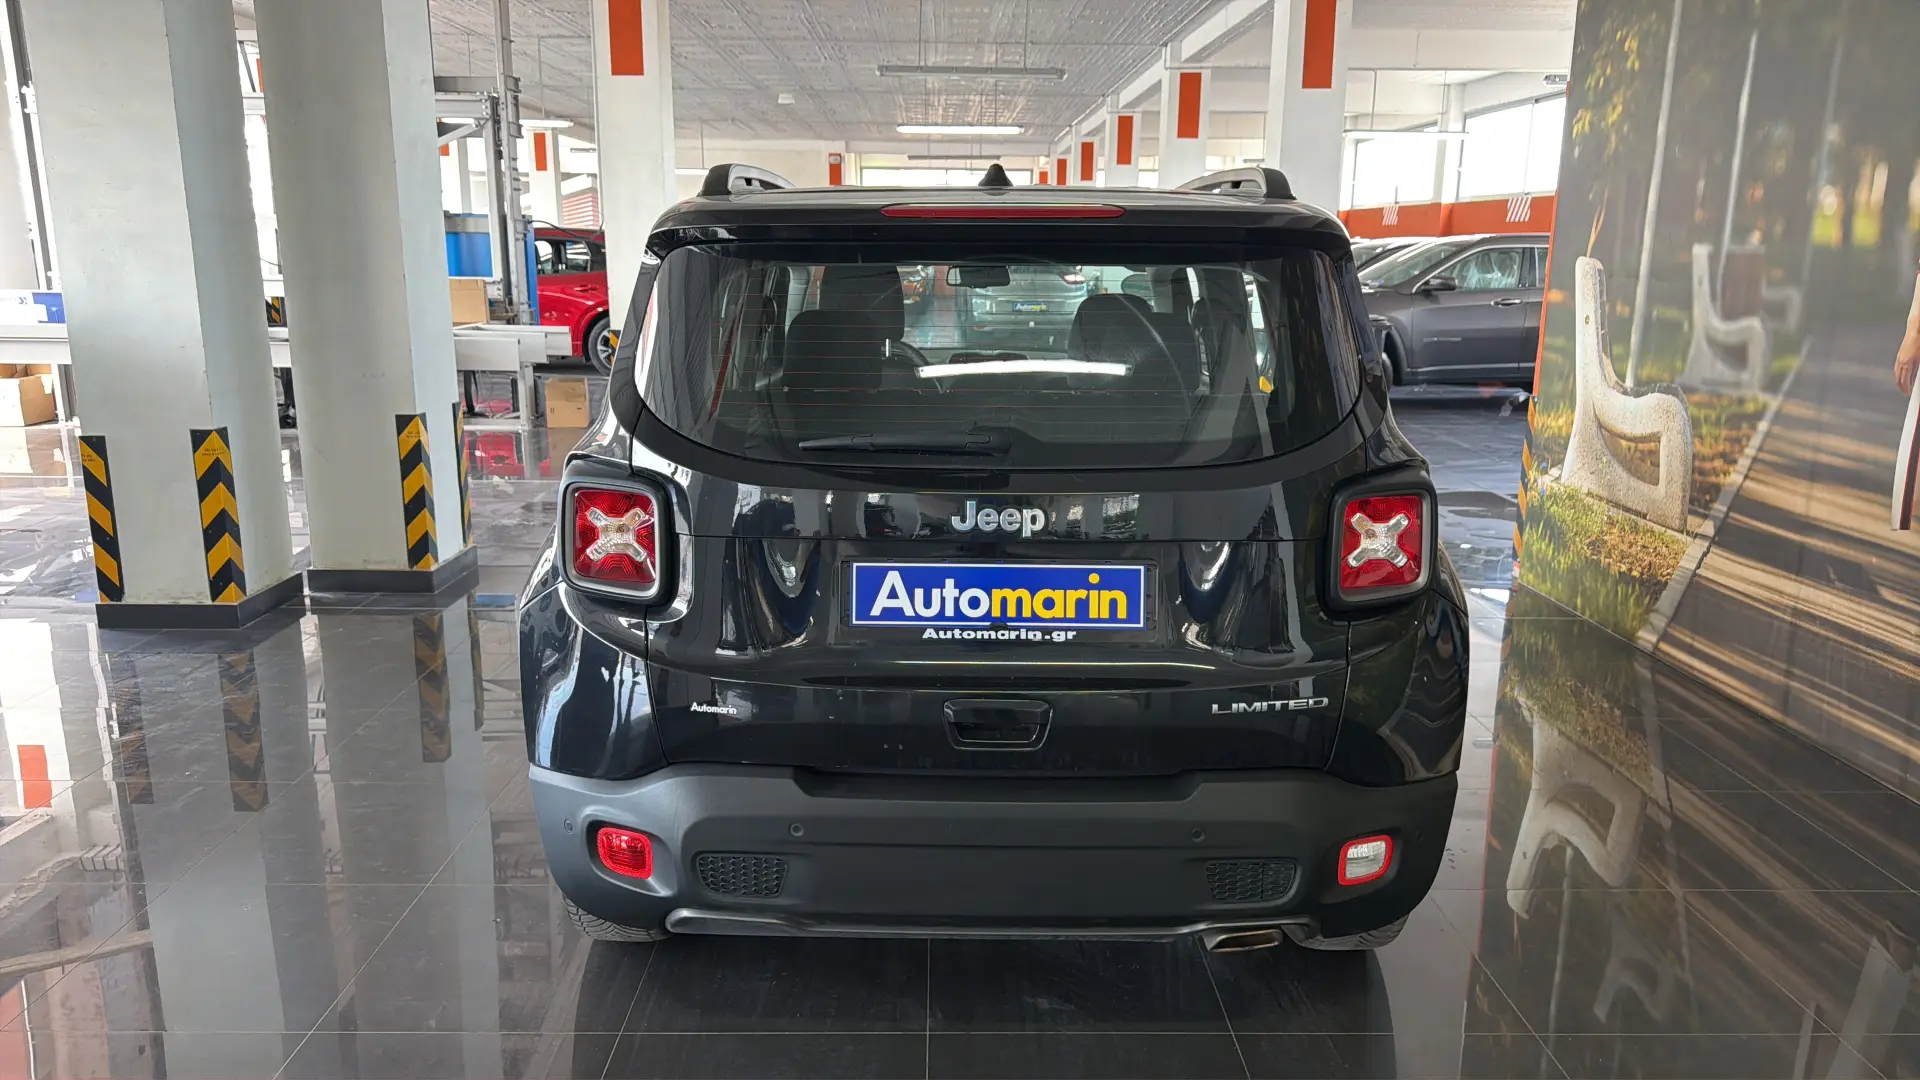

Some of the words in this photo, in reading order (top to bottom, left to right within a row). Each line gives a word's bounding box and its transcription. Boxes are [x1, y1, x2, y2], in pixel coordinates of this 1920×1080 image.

[951, 500, 1046, 538] Jeep
[869, 570, 1128, 619] Automarin
[922, 628, 1077, 642] Automarin.gr
[690, 701, 737, 715] Automarin
[1211, 696, 1329, 715] LIMITED
